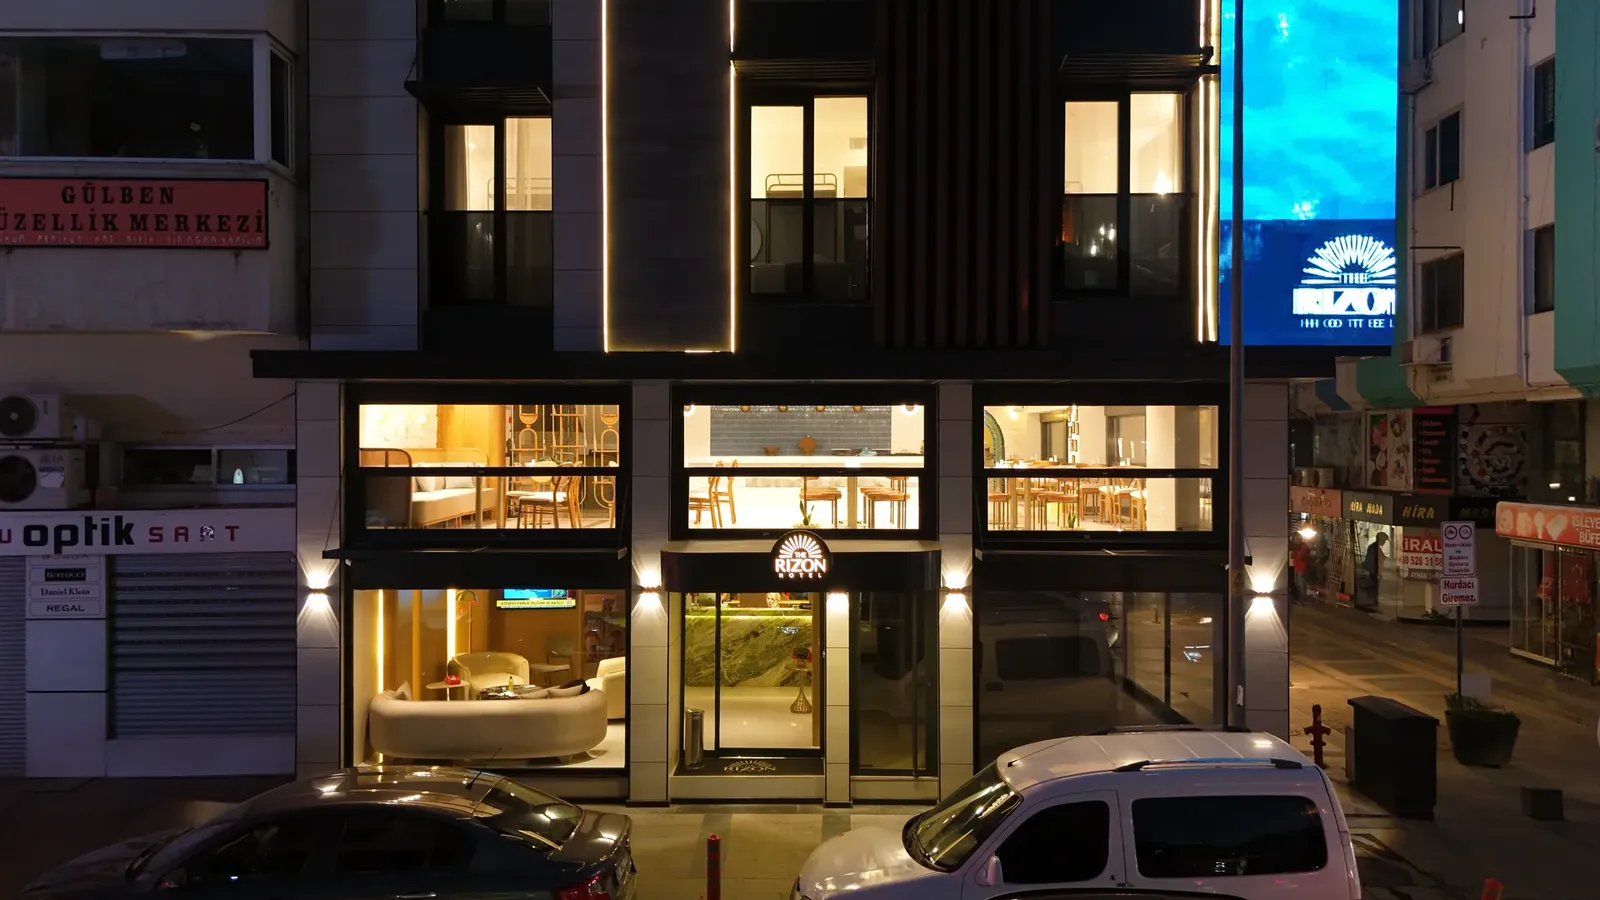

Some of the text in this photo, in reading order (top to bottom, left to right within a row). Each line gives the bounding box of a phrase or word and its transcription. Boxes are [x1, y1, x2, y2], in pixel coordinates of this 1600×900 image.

[61, 182, 175, 204] GÜLBEN
[0, 207, 264, 233] ÜZELLİK MERKEZİ
[1402, 505, 1434, 518] HİRA
[23, 515, 134, 554] optik
[774, 559, 826, 572] RIZON
[1410, 556, 1423, 566] 528
[1444, 580, 1474, 590] Hurdacı
[41, 588, 67, 596] Daniel
[1442, 593, 1477, 603] Giremez.
[46, 604, 85, 612] REGAL
